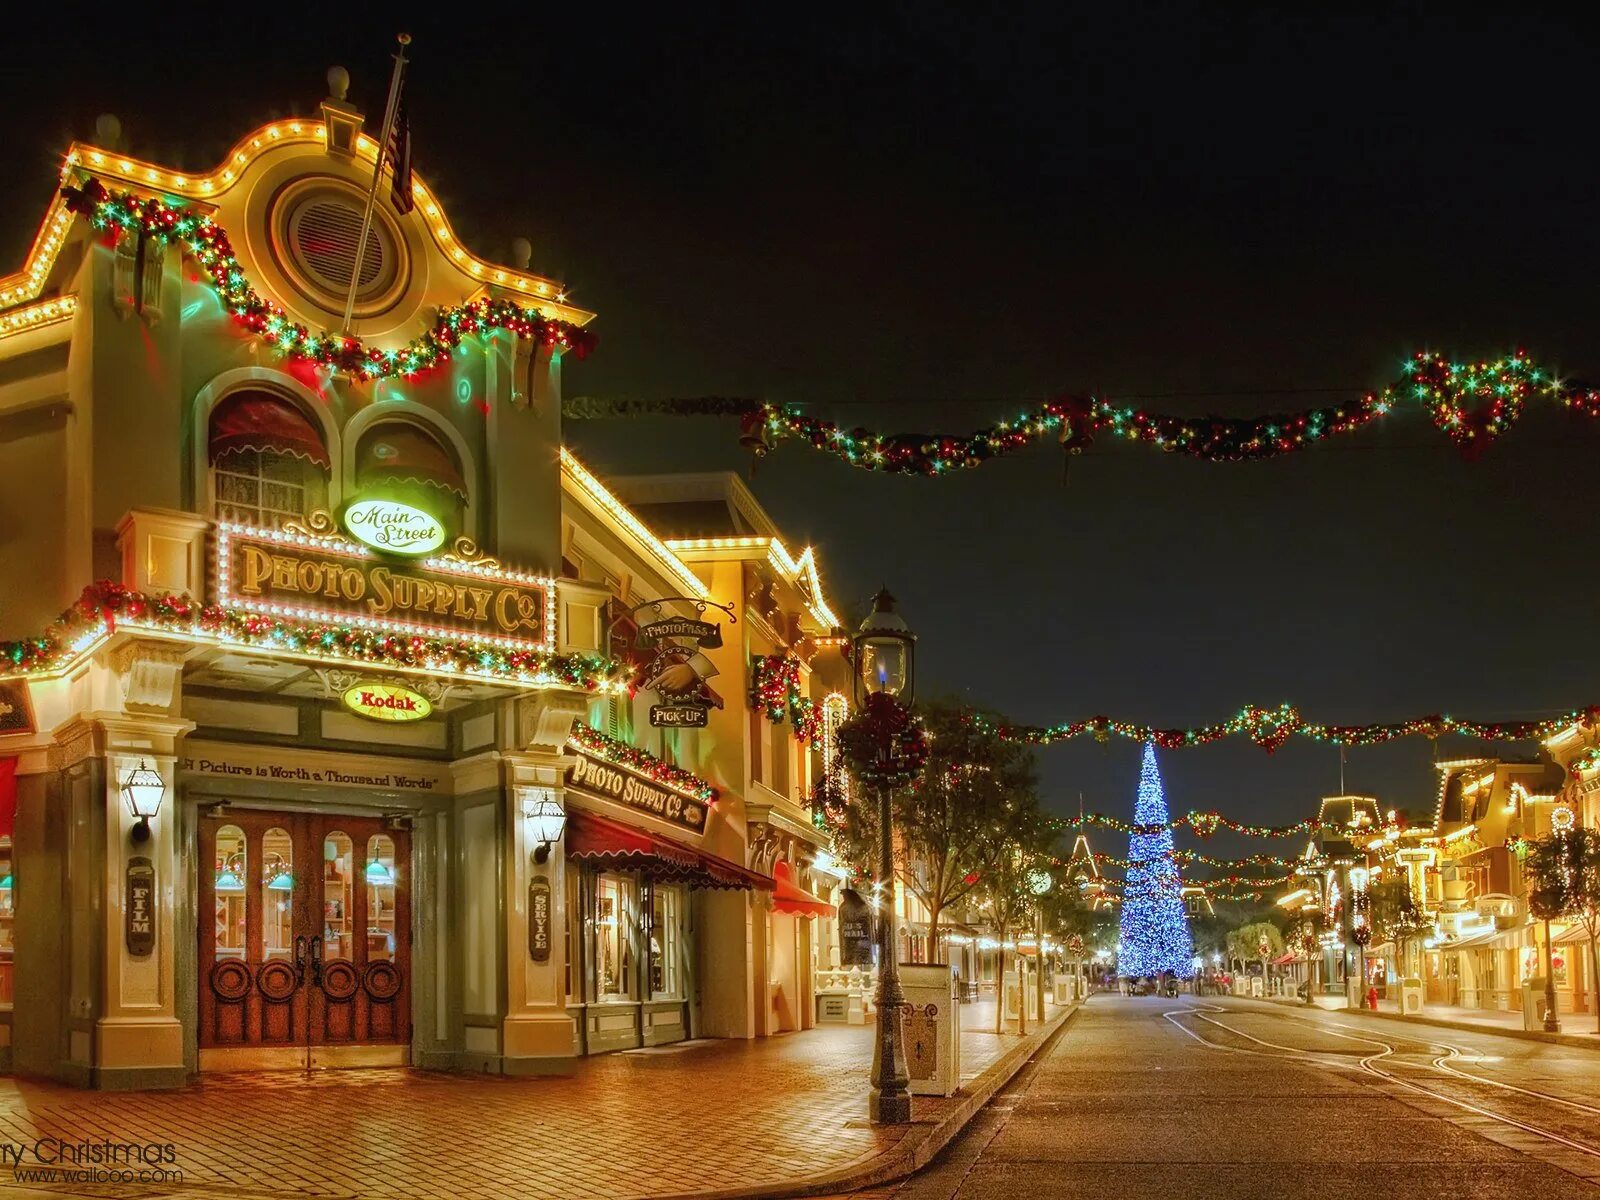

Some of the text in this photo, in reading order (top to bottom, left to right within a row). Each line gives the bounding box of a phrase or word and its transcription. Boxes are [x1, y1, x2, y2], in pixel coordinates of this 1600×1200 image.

[351, 505, 424, 529] Main
[375, 524, 436, 547] Street
[242, 545, 366, 601] PHOTO
[367, 567, 493, 620] SUPPLY
[361, 692, 416, 711] Kodak
[656, 710, 702, 722] PICK-UP
[200, 760, 252, 776] Picture
[256, 765, 267, 776] is
[270, 765, 310, 780] Worth
[313, 772, 323, 782] a
[325, 770, 390, 786] Thousand
[572, 754, 623, 794] PHOTO
[623, 776, 667, 812] SUPPLY
[132, 888, 150, 933] FILM
[534, 895, 547, 949] SERVICE
